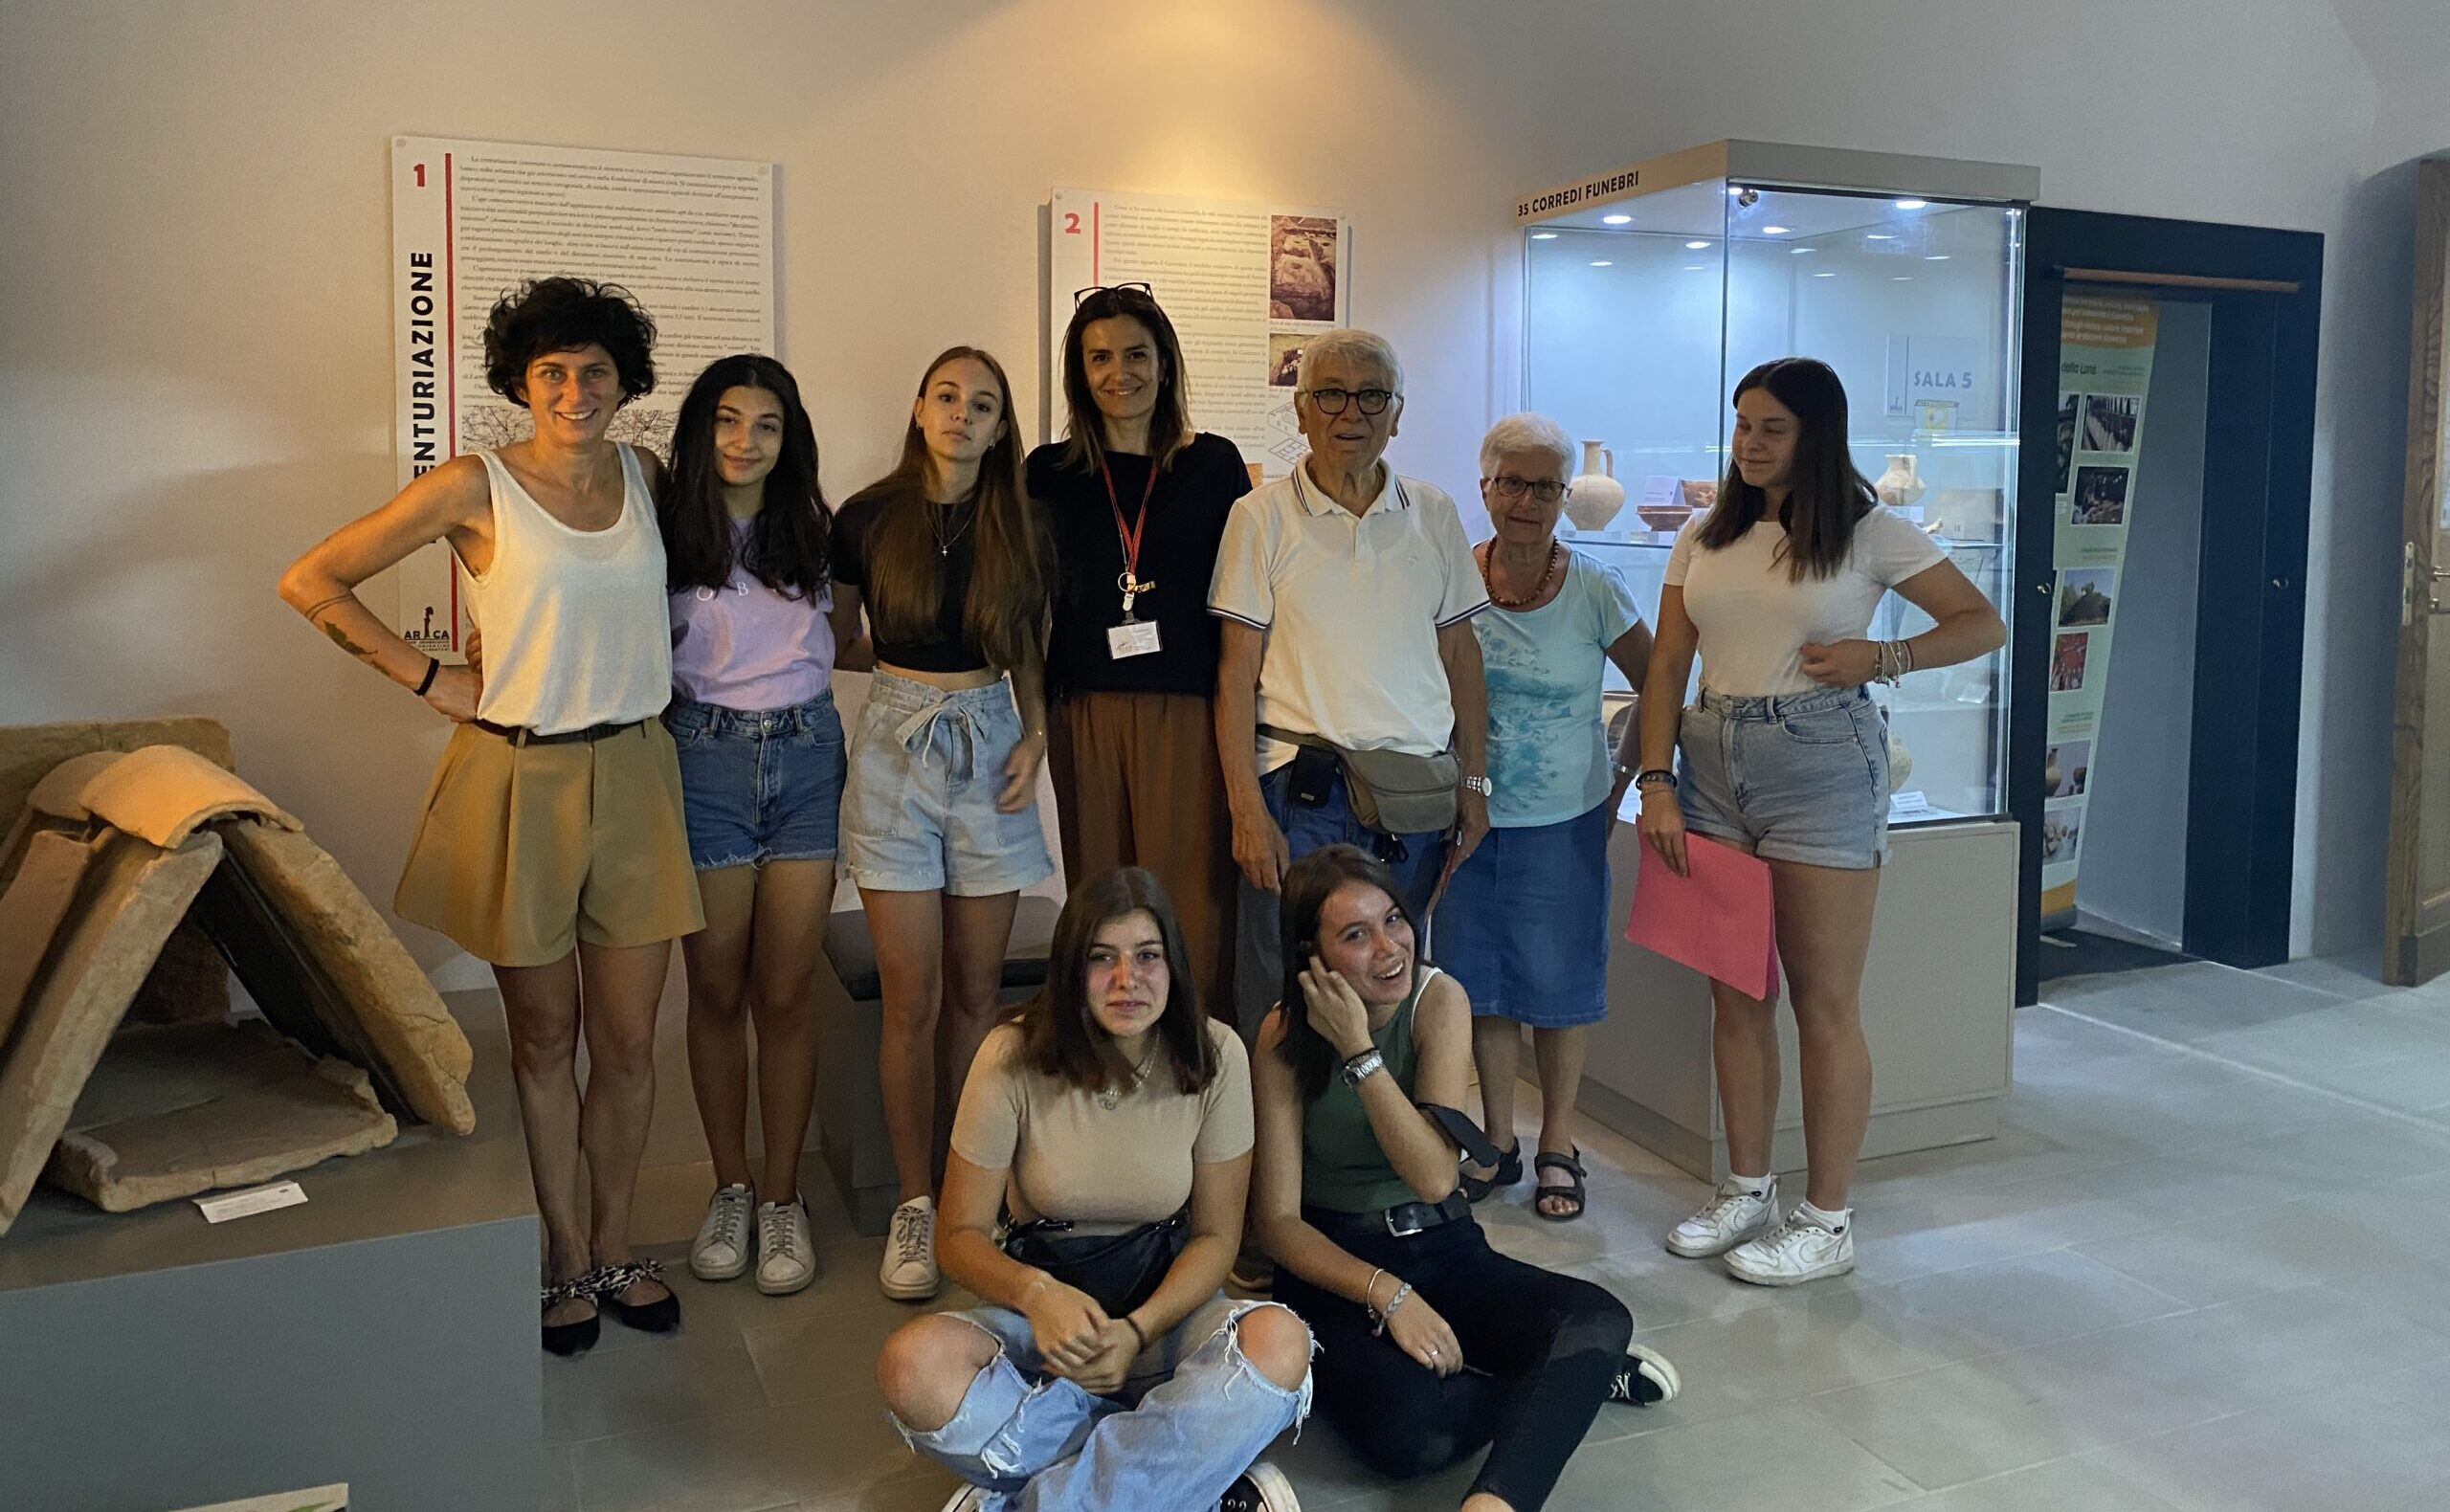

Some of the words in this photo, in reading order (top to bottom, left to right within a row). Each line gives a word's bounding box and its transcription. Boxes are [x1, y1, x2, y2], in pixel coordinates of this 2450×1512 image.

[413, 164, 426, 188] 1
[1518, 204, 1529, 217] 35
[1532, 187, 1582, 213] CORREDI
[1586, 170, 1639, 200] FUNEBRI
[1065, 212, 1081, 234] 2
[411, 252, 435, 479] ENTURIAZIONE
[1914, 371, 1956, 389] SALA
[1962, 371, 1972, 389] 5
